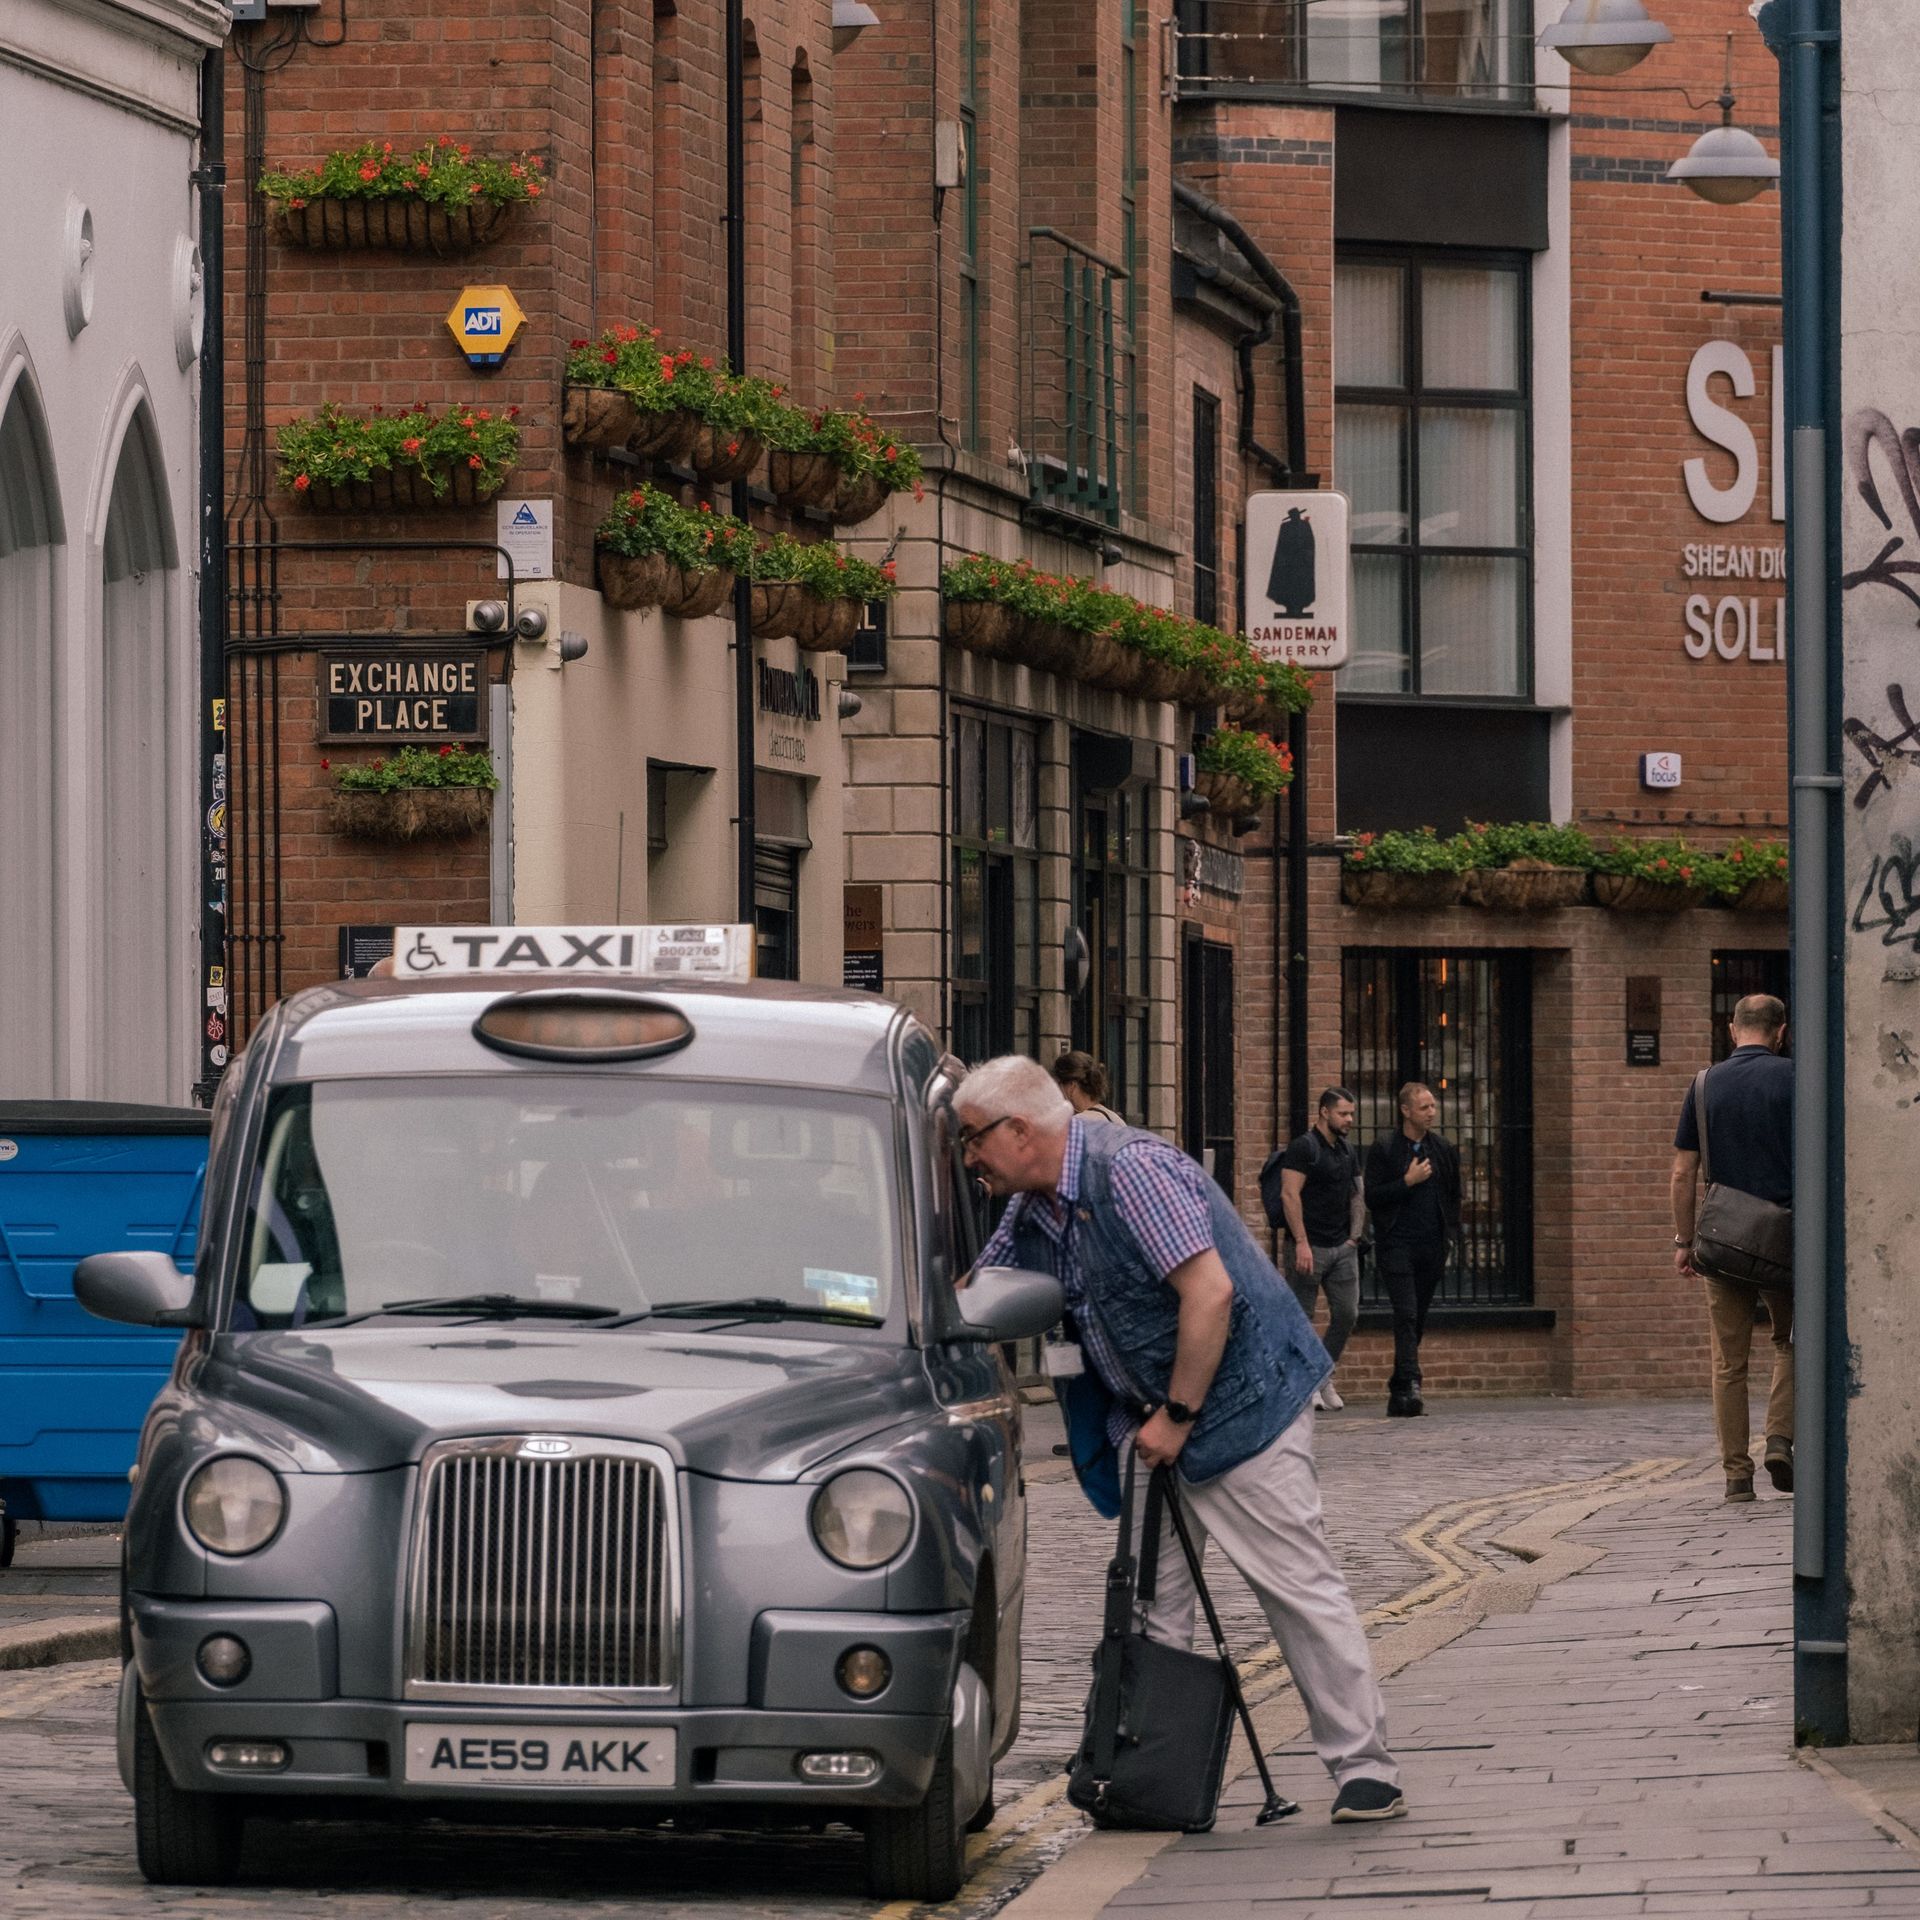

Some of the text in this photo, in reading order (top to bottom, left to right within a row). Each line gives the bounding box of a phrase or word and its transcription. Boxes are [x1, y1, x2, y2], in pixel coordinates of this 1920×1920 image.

[465, 311, 501, 331] ADT
[1682, 543, 1754, 578] SHEAN
[1253, 626, 1337, 641] SANDEMAN
[1684, 594, 1786, 660] SOLI
[1261, 644, 1332, 656] SHERRY
[330, 662, 476, 693] EXCHANGE
[358, 700, 448, 730] PLACE
[1652, 767, 1677, 782] focus
[453, 935, 633, 967] TAXI
[659, 946, 720, 956] B002765
[431, 1738, 650, 1772] AE59 AKK
